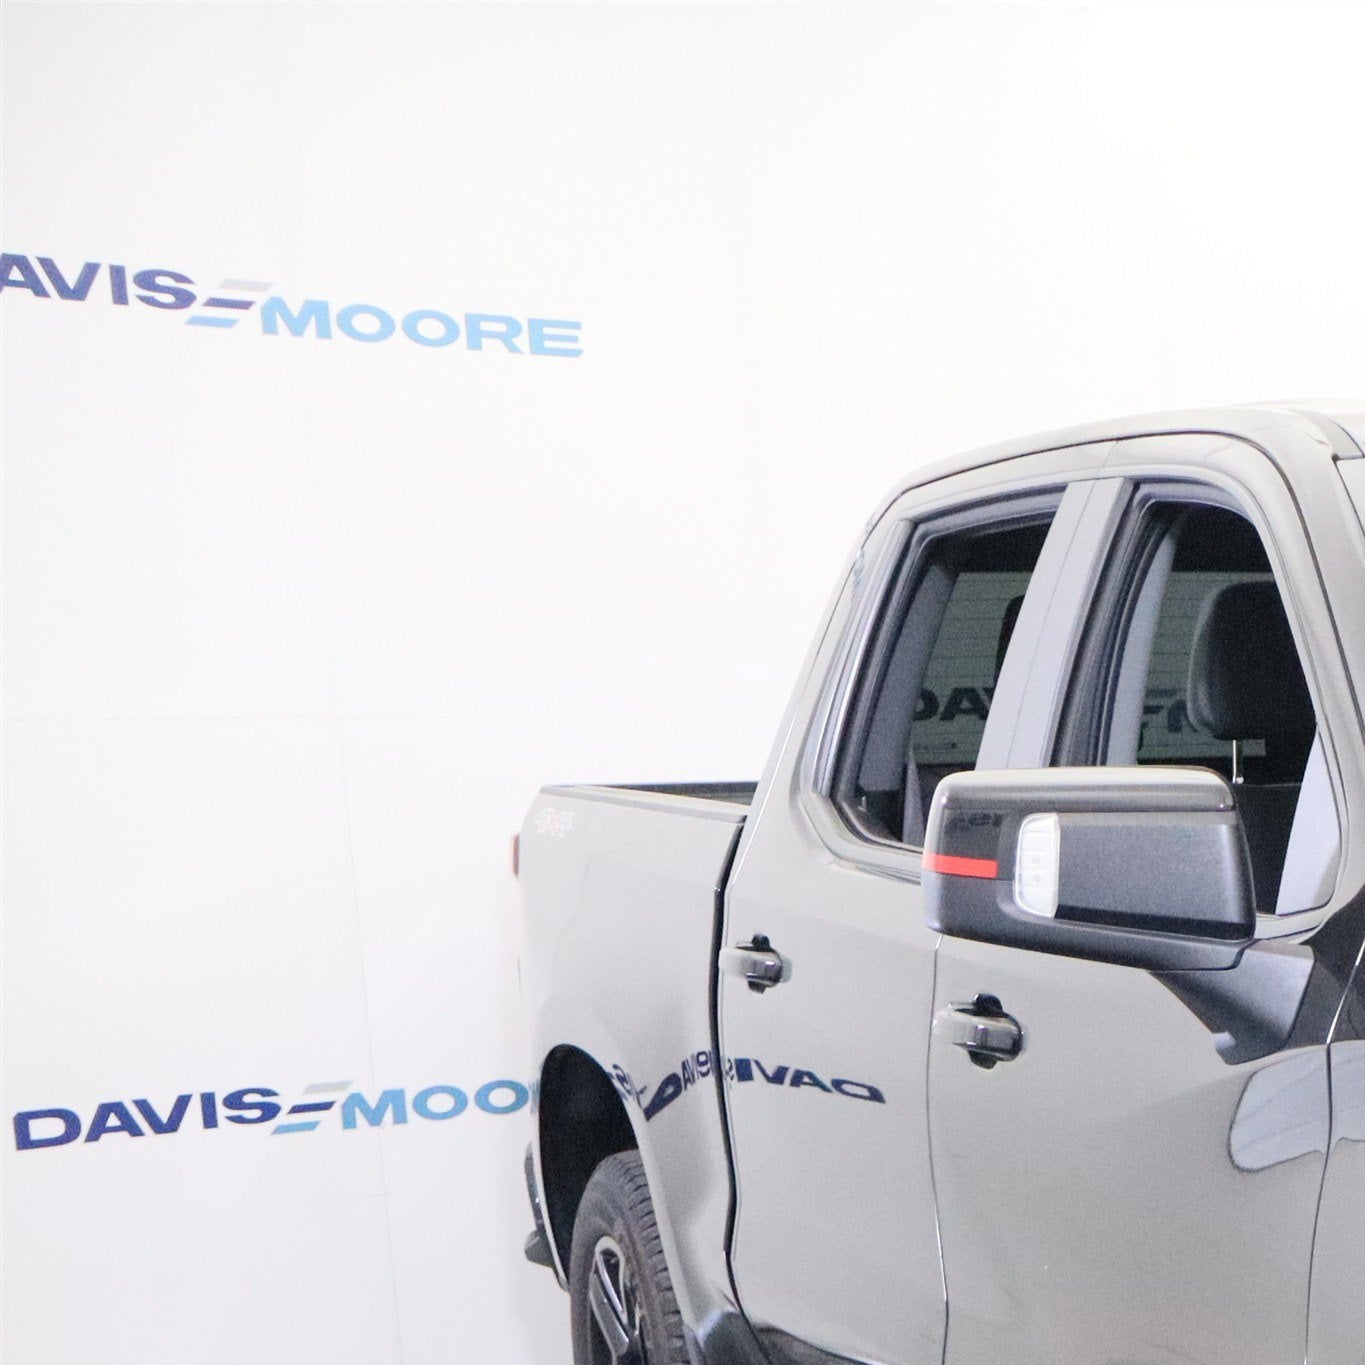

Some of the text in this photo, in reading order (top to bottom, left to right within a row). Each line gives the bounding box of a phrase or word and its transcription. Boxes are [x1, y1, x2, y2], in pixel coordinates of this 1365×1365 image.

[0, 252, 585, 358] AVIS MOORE
[12, 1087, 282, 1151] DAVIS
